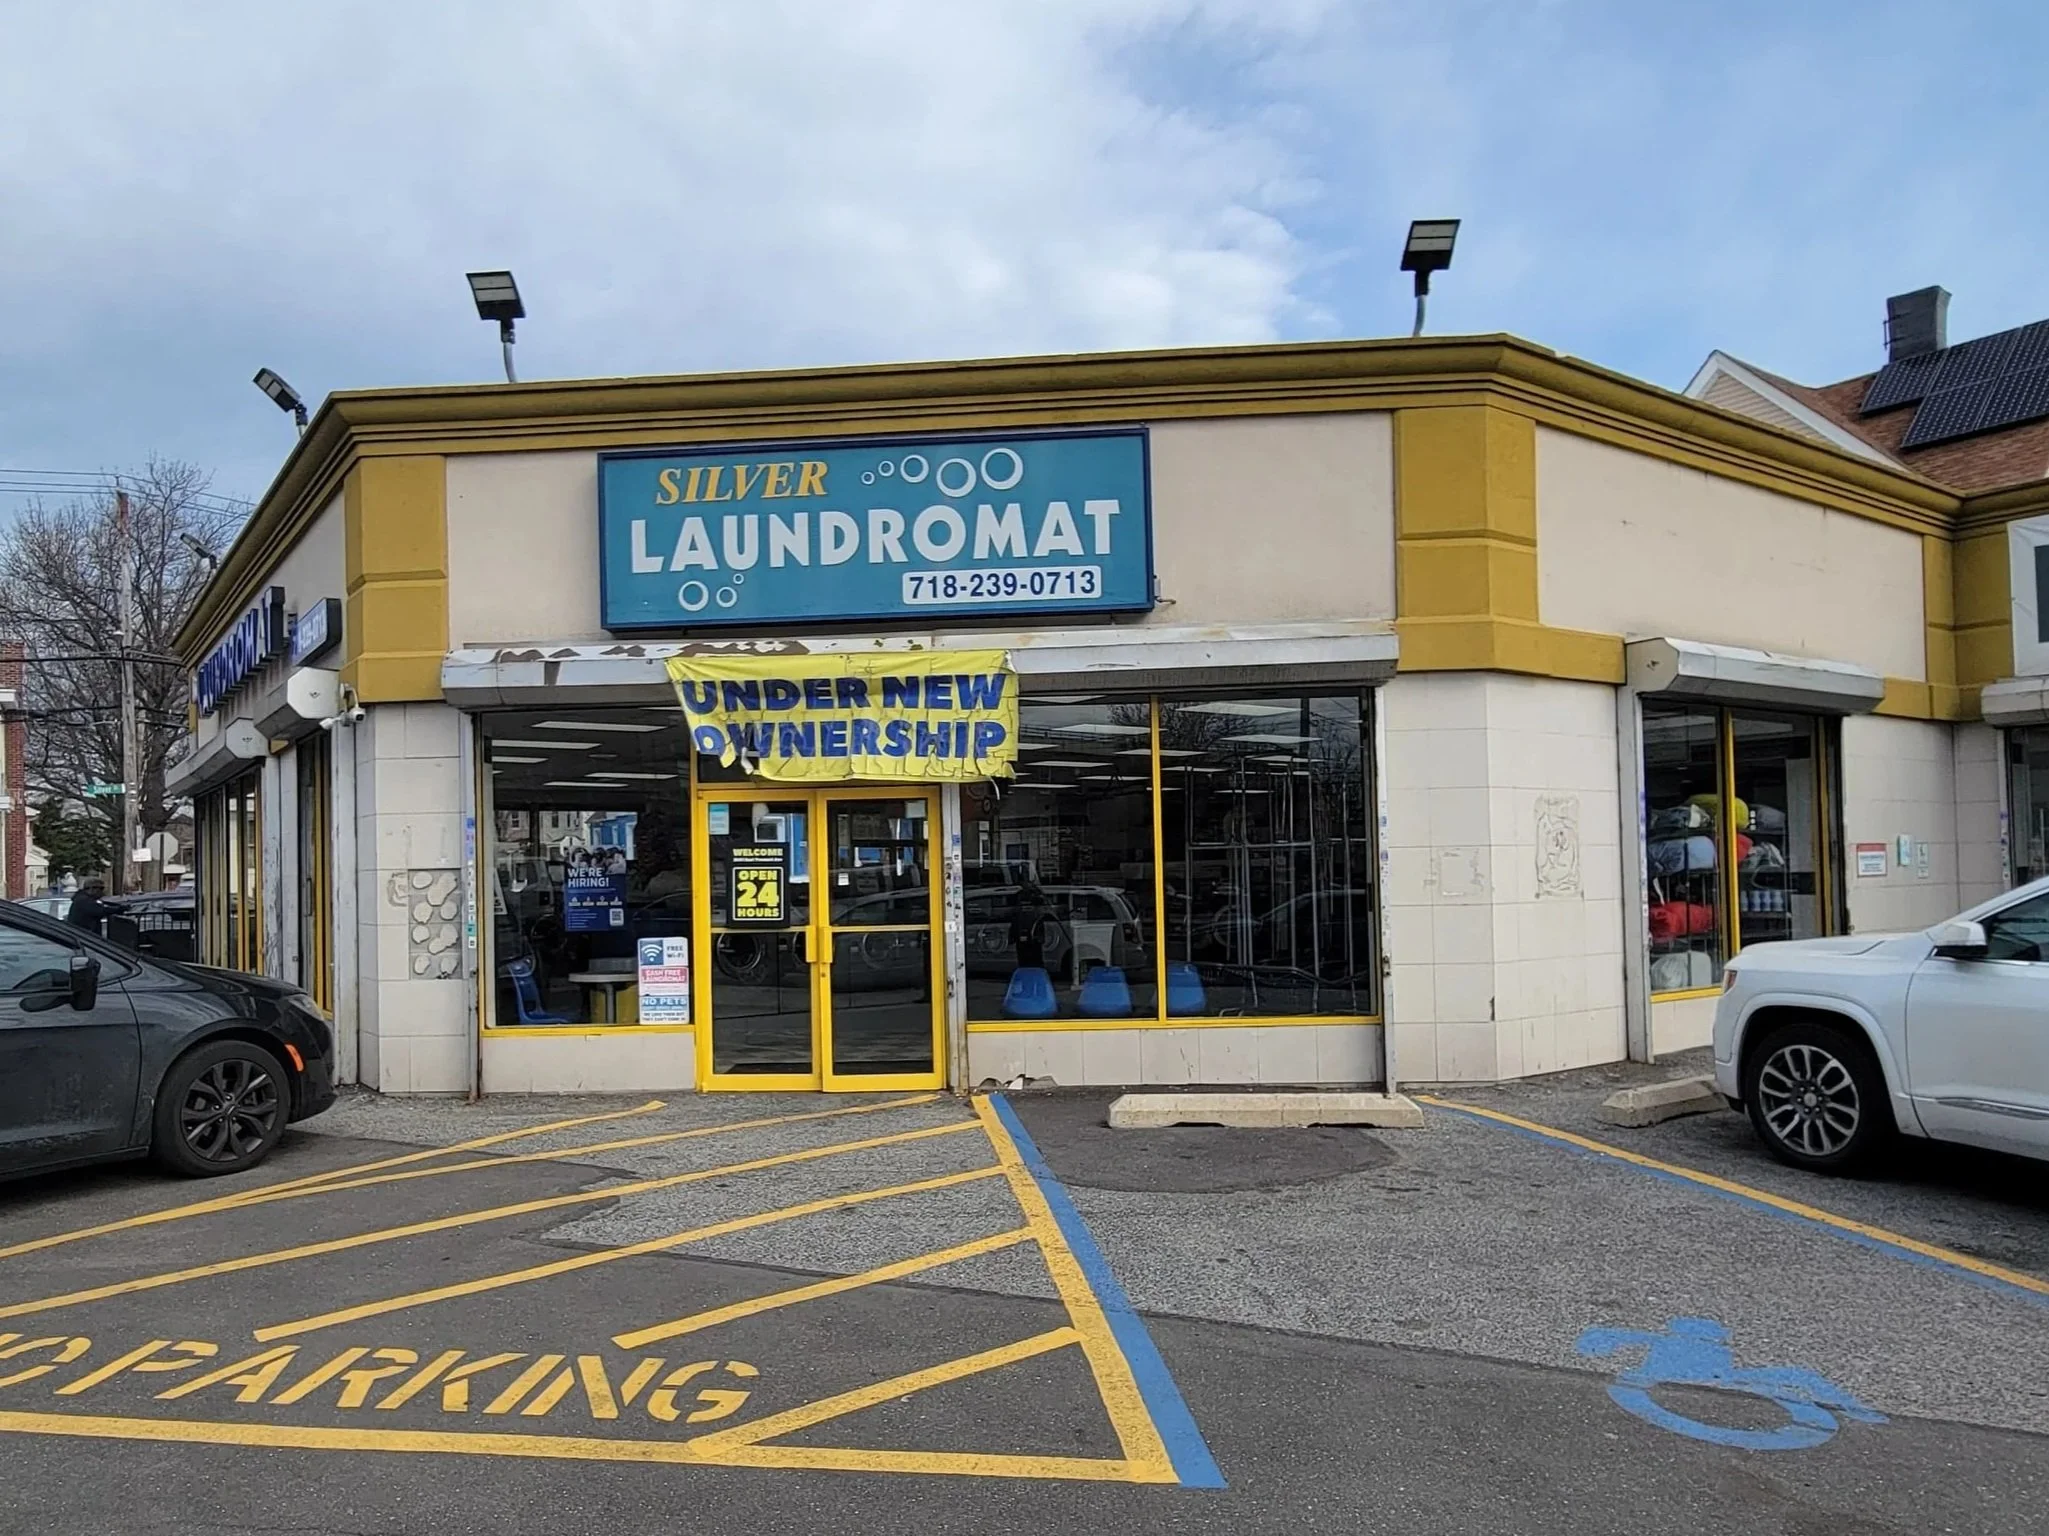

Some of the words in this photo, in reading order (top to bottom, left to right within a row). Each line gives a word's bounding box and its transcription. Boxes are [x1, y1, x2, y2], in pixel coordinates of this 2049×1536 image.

[656, 461, 828, 505] SILVER
[631, 500, 1120, 574] LAUNDROMAT
[908, 569, 1096, 600] 718-239-0713
[196, 586, 284, 718] AUNDROMAT
[681, 676, 873, 716] UNDER
[881, 673, 1007, 711] NEW
[693, 718, 1006, 759] OWNERSHIP
[733, 848, 783, 857] WELCOME
[567, 867, 603, 878] WE'RE
[567, 877, 609, 888] HIRING!
[739, 870, 777, 880] OPEN
[736, 881, 780, 908] 24
[737, 907, 780, 918] HOURS
[54, 1339, 761, 1424] PARKING
